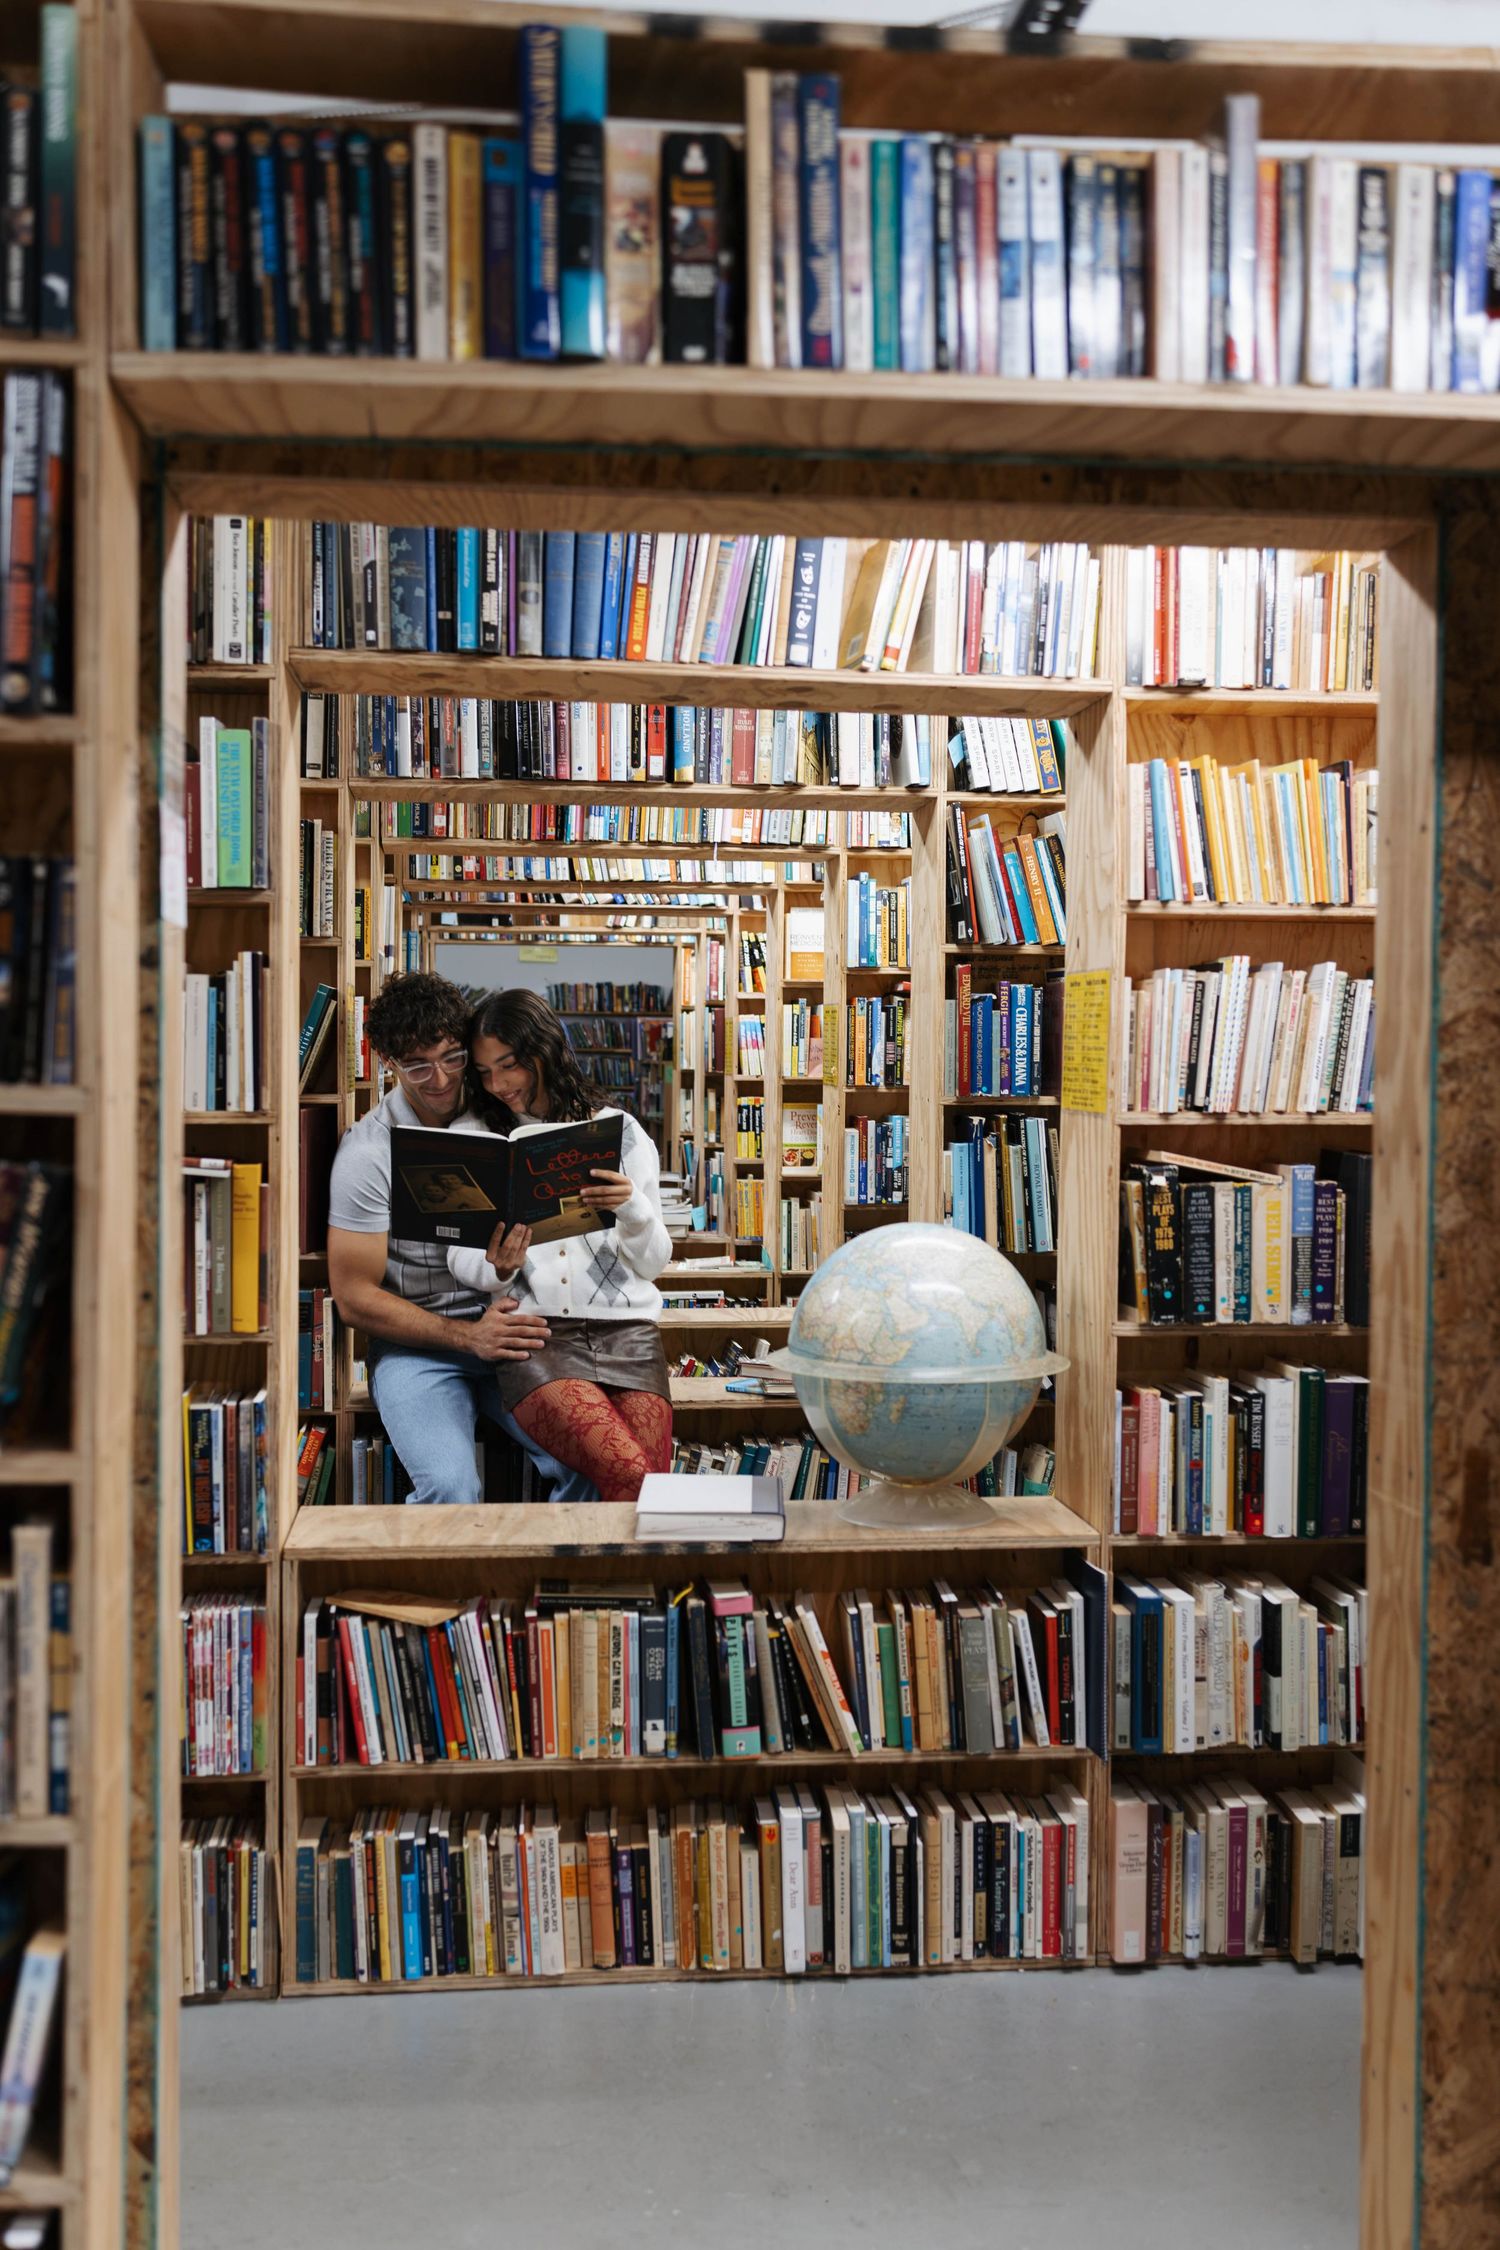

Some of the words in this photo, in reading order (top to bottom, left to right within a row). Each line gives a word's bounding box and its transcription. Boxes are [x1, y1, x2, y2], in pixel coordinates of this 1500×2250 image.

[231, 533, 240, 546] Ben
[231, 547, 240, 570] Jonson
[231, 591, 240, 618] Cavalier
[682, 709, 691, 753] HOLLAND
[230, 742, 241, 761] THE
[230, 765, 241, 787] NEW
[230, 790, 241, 833] OXFORD
[230, 835, 241, 865] BOOK
[323, 836, 334, 869] HERE
[323, 871, 334, 880] IS
[1025, 855, 1040, 888] HENRY
[323, 882, 334, 926] FRANCE
[962, 974, 971, 1009] EDWARD
[1000, 985, 1009, 1016] FERGIE
[962, 1011, 971, 1026] VIII
[1015, 1007, 1027, 1049] CHARLES
[1192, 1021, 1200, 1035] NEW
[1015, 1049, 1027, 1057] &
[1190, 1036, 1199, 1064] THEATER
[1015, 1057, 1027, 1086] DIANA
[525, 1148, 617, 1176] Letters
[560, 1171, 582, 1183] to
[1033, 1164, 1042, 1190] ROYAL
[1036, 1190, 1044, 1217] FAMILY
[1152, 1204, 1175, 1216] PLAYS
[1154, 1192, 1172, 1204] BEST
[1159, 1215, 1170, 1227] OF
[1223, 1221, 1231, 1237] Plays
[1265, 1199, 1281, 1242] NEIL
[216, 1246, 225, 1260] The
[215, 1262, 225, 1294] Blessing
[1265, 1245, 1281, 1304] SIMON
[1192, 1400, 1201, 1427] Annie
[1252, 1397, 1263, 1414] TIM
[1192, 1429, 1201, 1460] PROULX
[1251, 1415, 1263, 1449] RUSSERT
[1181, 1608, 1190, 1632] Letters
[612, 1625, 620, 1658] anyone
[726, 1618, 739, 1658] PLAYS
[1181, 1634, 1190, 1652] From
[241, 1654, 249, 1694] Reflections
[612, 1660, 621, 1676] can
[648, 1647, 656, 1681] O'NEILL
[655, 1647, 663, 1681] EUGENE
[1062, 1655, 1070, 1700] TOWNE
[1181, 1654, 1190, 1679] Heaven
[1214, 1642, 1225, 1692] EDWARD
[241, 1694, 249, 1703] of
[1181, 1699, 1190, 1725] Volume
[241, 1710, 249, 1751] Peacemaker
[539, 1838, 546, 1850] OF
[995, 1826, 1005, 1840] Joe
[1216, 1826, 1225, 1864] ALICE
[547, 1838, 555, 1868] FAMOUS
[1026, 1835, 1034, 1859] Sherlock
[503, 1854, 515, 1887] Quadrille
[788, 1862, 798, 1885] Dear
[896, 1848, 904, 1874] William
[995, 1866, 1006, 1878] The
[1026, 1860, 1034, 1880] Holmes
[549, 1869, 557, 1909] AMERICAN
[790, 1888, 799, 1909] Ann
[994, 1880, 1006, 1912] Complete
[1216, 1871, 1225, 1918] MUNRO
[541, 1901, 549, 1915] THE
[994, 1913, 1006, 1932] Plays
